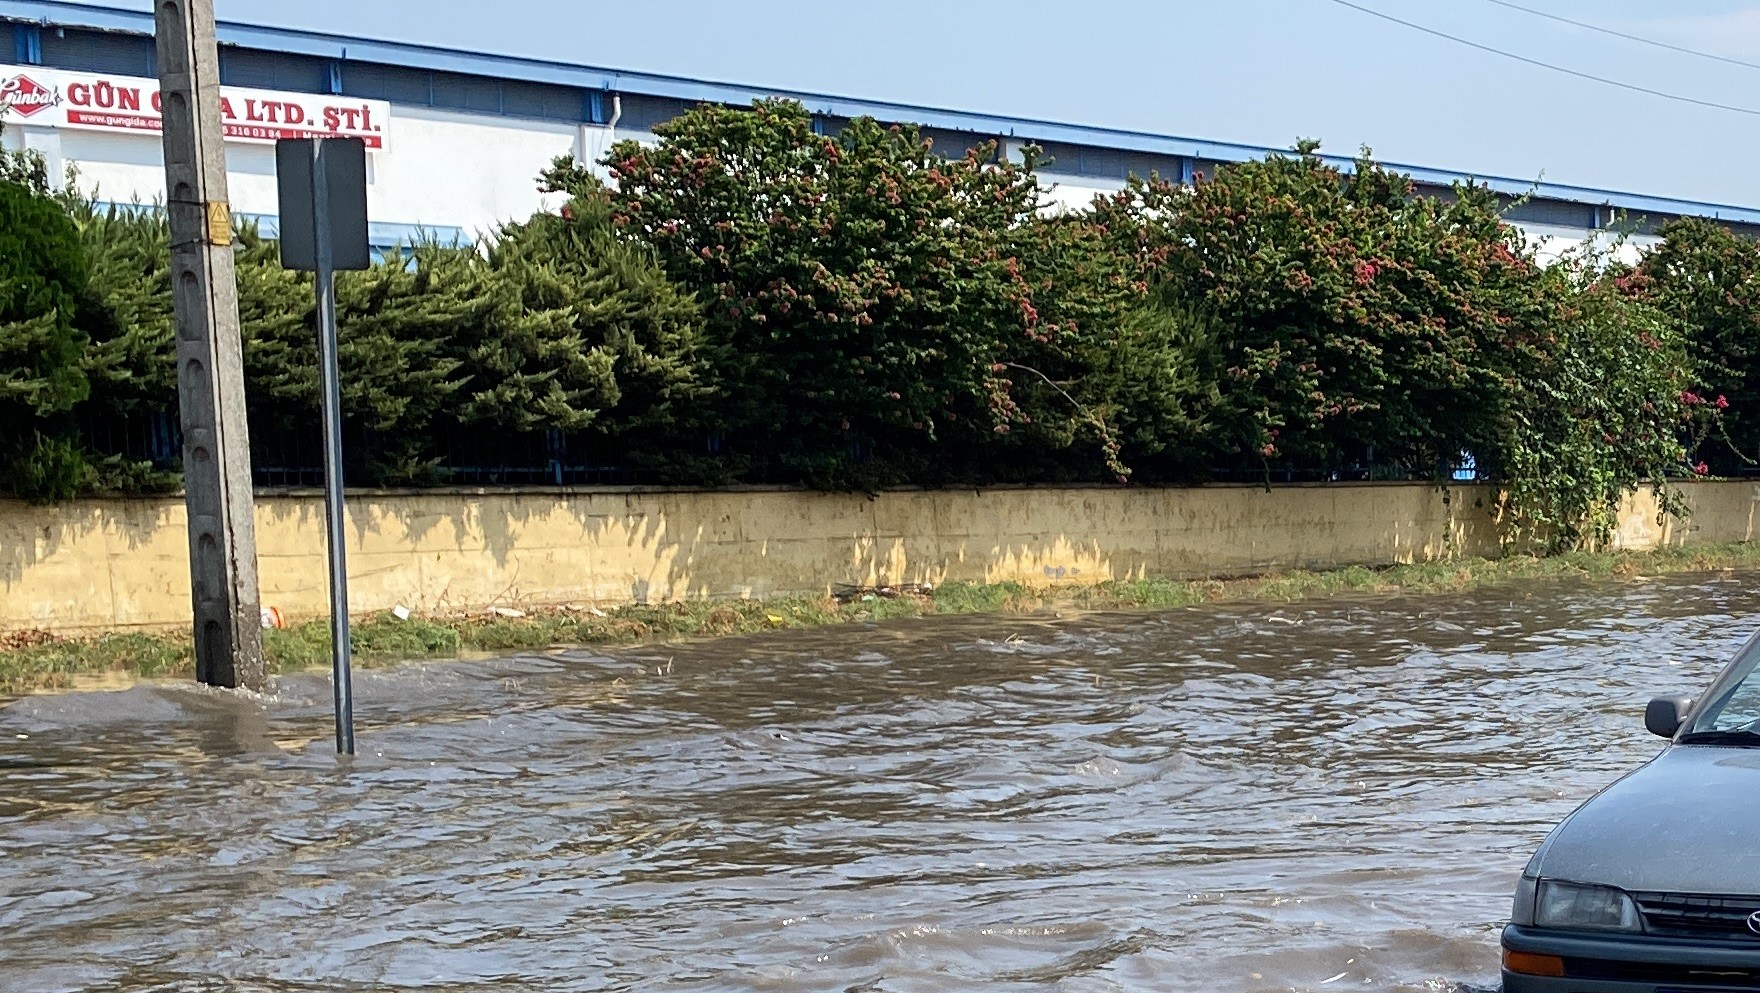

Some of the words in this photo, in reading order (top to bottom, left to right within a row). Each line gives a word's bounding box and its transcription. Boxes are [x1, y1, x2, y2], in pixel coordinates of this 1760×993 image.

[67, 80, 140, 111] GÜN
[244, 99, 314, 126] LTD.
[323, 104, 381, 133] ŞTİ.
